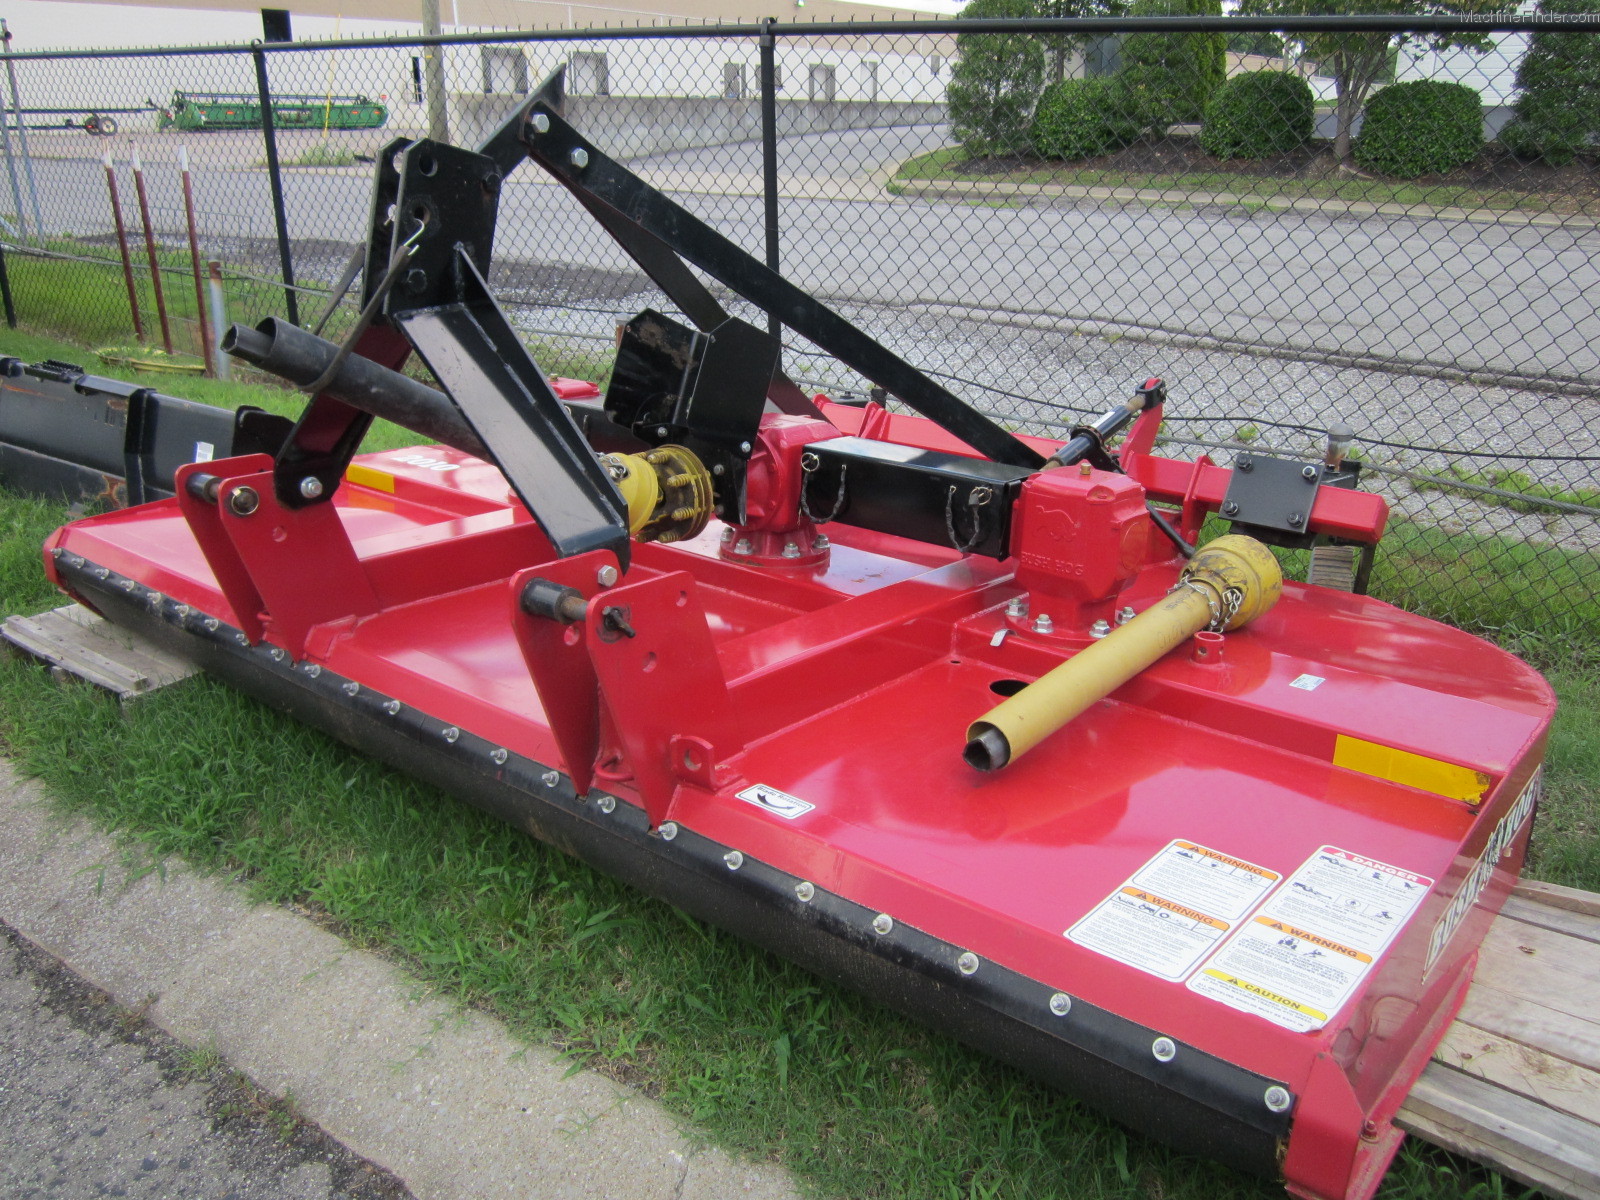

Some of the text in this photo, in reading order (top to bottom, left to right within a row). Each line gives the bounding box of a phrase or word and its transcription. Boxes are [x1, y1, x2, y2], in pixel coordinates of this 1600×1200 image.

[1055, 559, 1084, 576] HOG
[1204, 850, 1264, 876] WARNING
[1352, 856, 1418, 882] DANGER
[1151, 897, 1214, 926] WARNING
[1290, 928, 1358, 958] WARNING
[1244, 984, 1301, 1010] CAUTION
